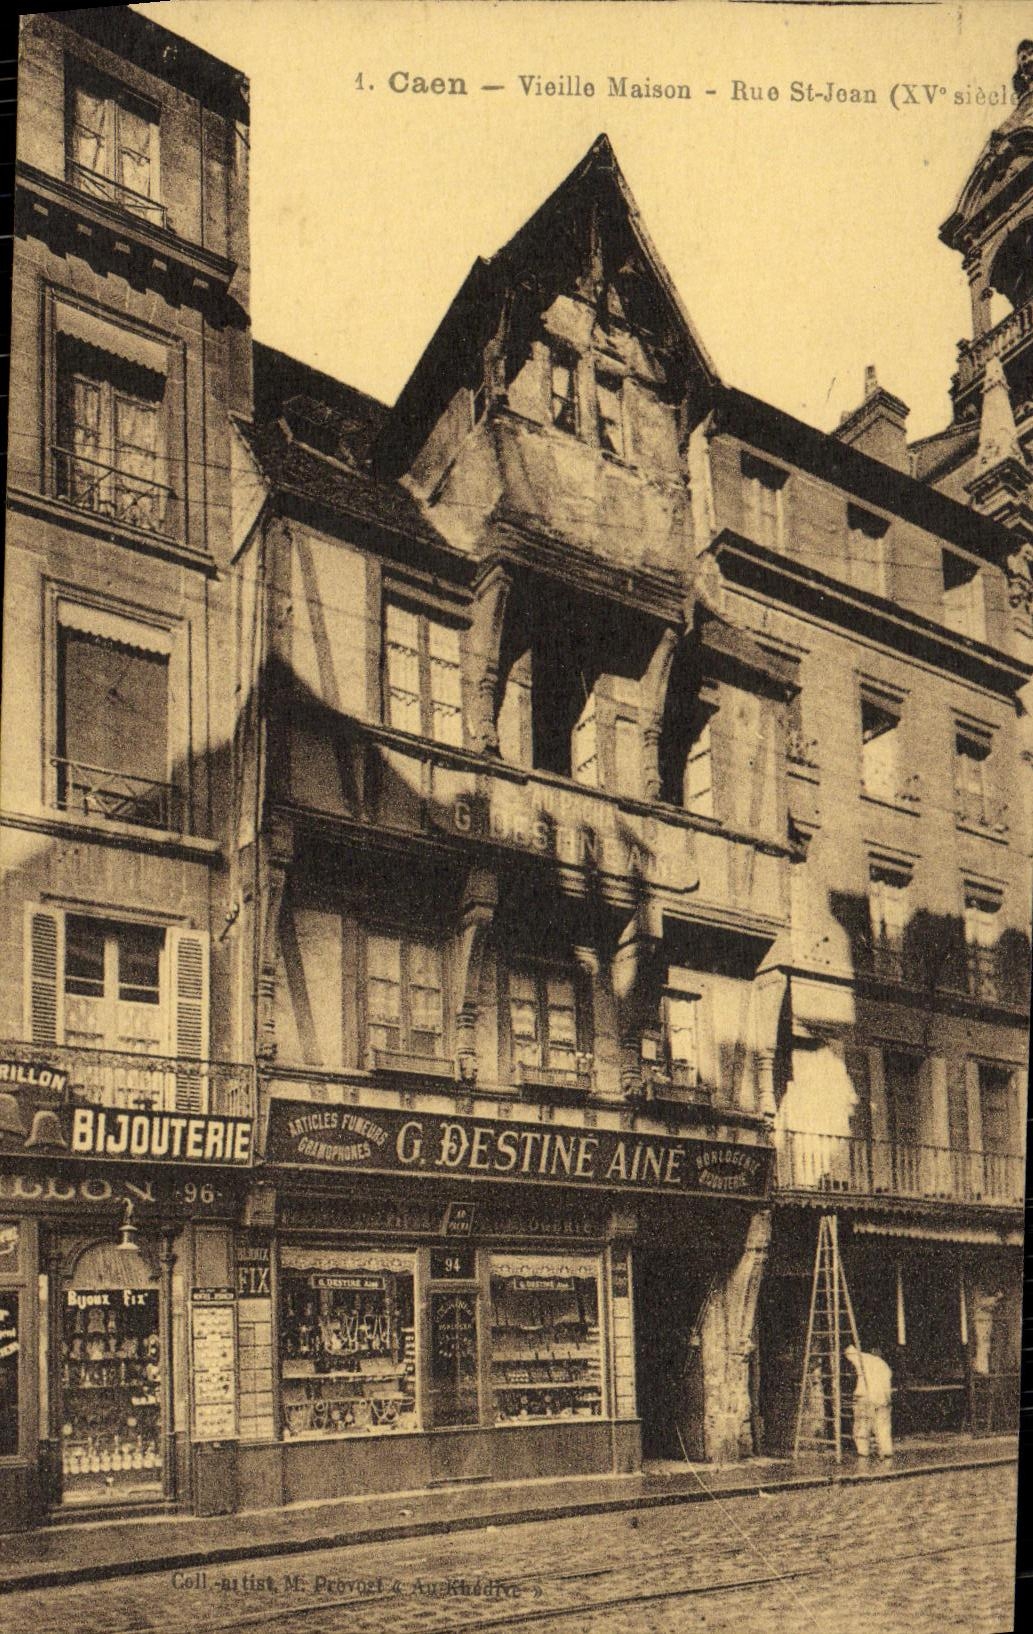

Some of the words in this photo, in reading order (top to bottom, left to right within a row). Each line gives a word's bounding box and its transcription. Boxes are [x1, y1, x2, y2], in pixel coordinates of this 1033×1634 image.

[72, 1107, 250, 1160] BIJOUTERIE
[287, 1111, 339, 1139] ARTICLES
[395, 1121, 426, 1164] G.
[184, 1183, 215, 1204] 96
[444, 1257, 462, 1273] 94
[238, 1267, 270, 1293] FIX
